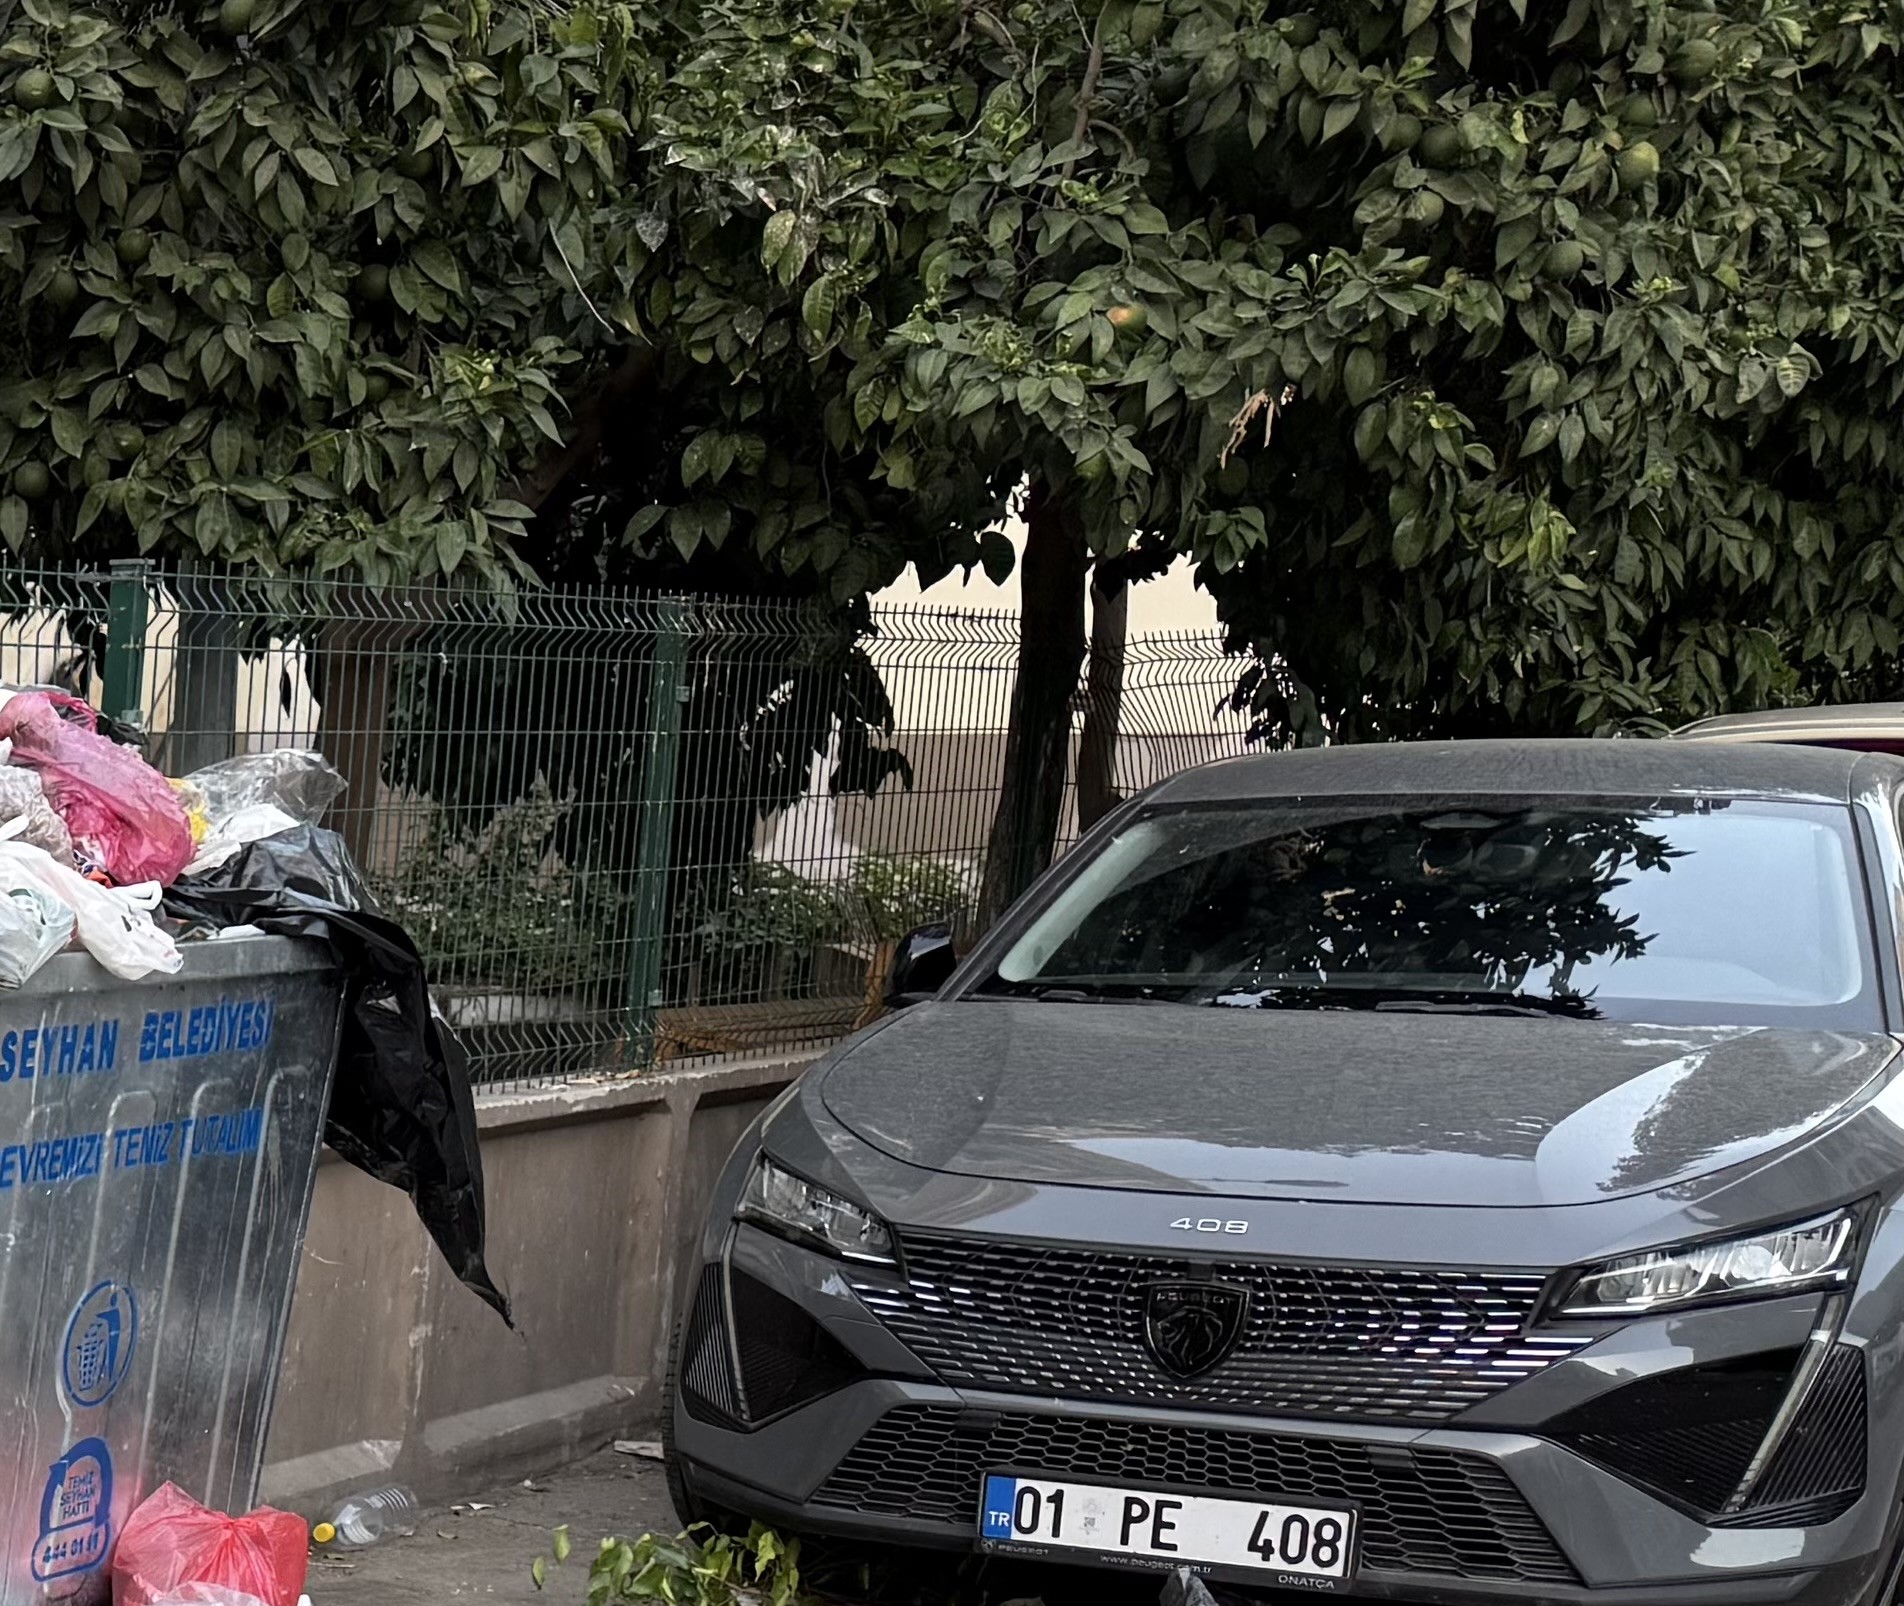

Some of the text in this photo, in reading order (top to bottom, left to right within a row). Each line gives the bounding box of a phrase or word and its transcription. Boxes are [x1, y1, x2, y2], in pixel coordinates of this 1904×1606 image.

[1170, 1218, 1248, 1233] 408
[988, 1510, 1009, 1527] TR
[1014, 1486, 1343, 1568] 01 PE 408
[1278, 1573, 1336, 1590] ONATÇA
